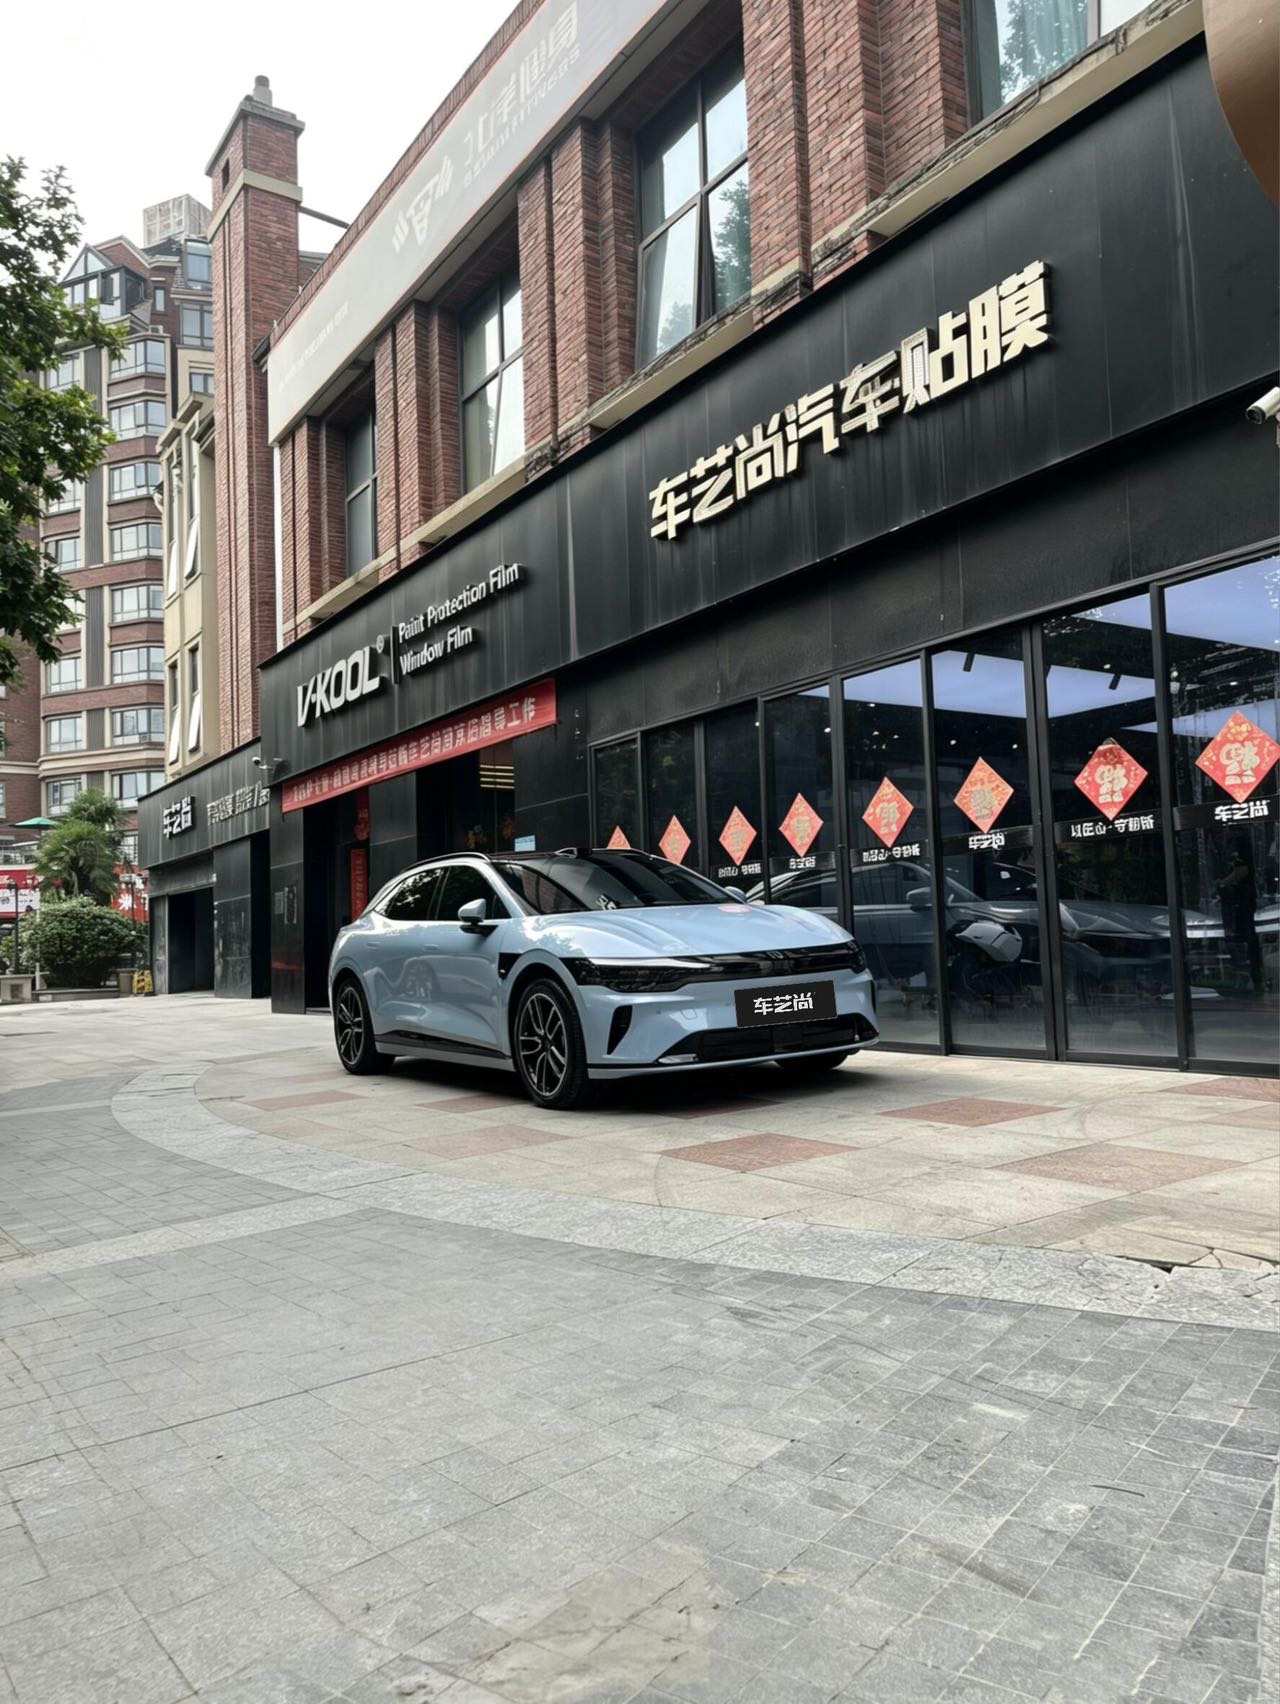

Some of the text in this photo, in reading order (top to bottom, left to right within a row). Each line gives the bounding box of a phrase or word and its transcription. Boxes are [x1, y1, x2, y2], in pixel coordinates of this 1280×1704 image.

[648, 259, 1049, 541] 车艺尚汽车贴膜
[398, 563, 520, 644] Paint Protection Film
[399, 625, 473, 676] Window Film
[752, 991, 815, 1016] 车艺尚
